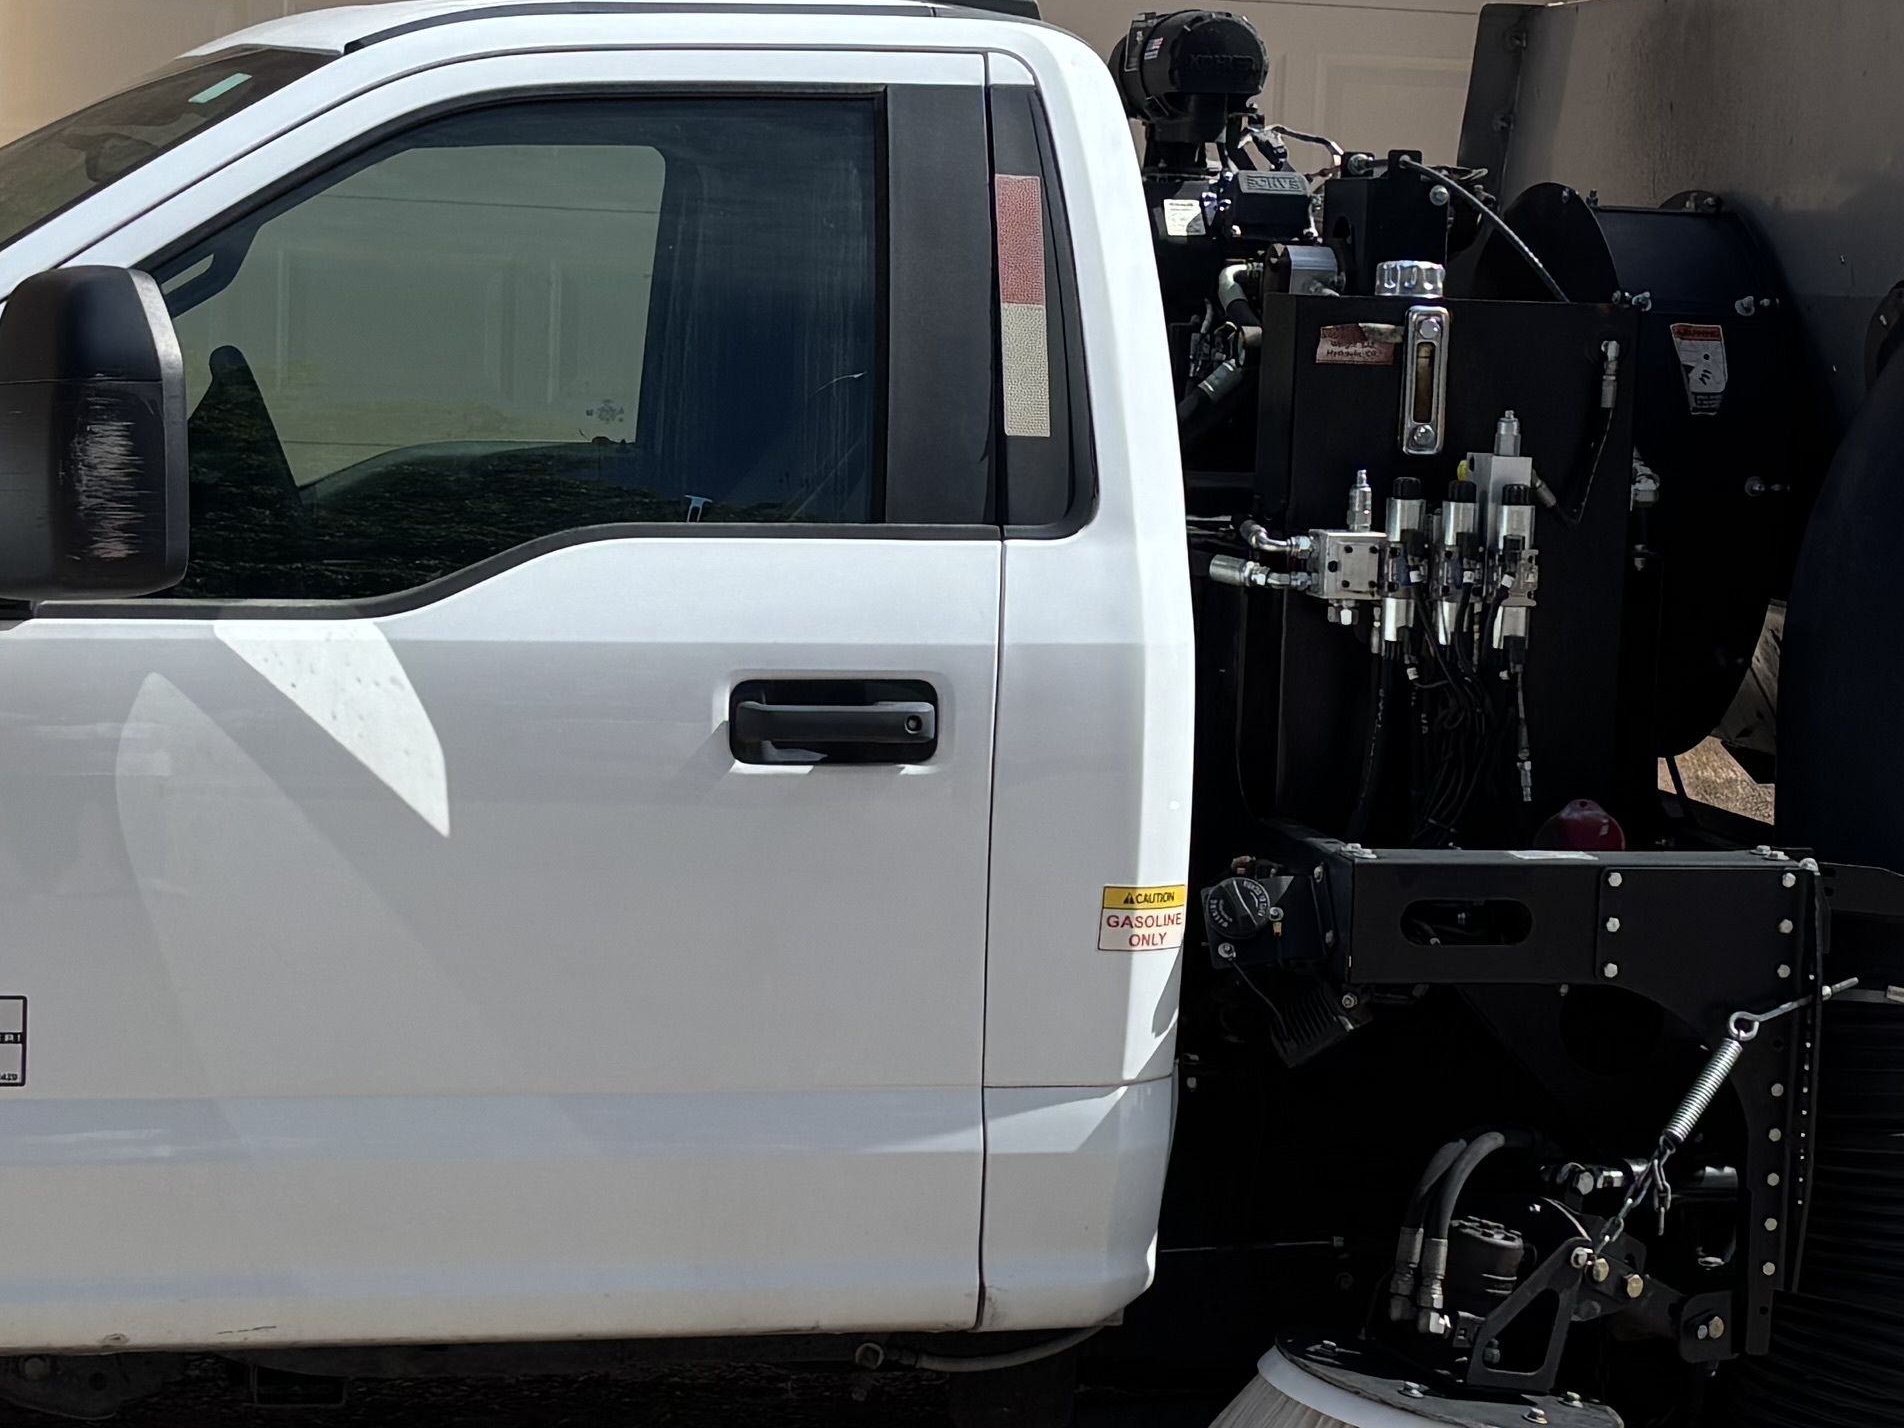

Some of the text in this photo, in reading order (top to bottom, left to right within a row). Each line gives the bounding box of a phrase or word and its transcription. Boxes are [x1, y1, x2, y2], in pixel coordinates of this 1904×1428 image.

[1135, 891, 1176, 904] CAUTION
[1106, 912, 1183, 929] GASOLINE
[1128, 932, 1168, 947] ONLY
